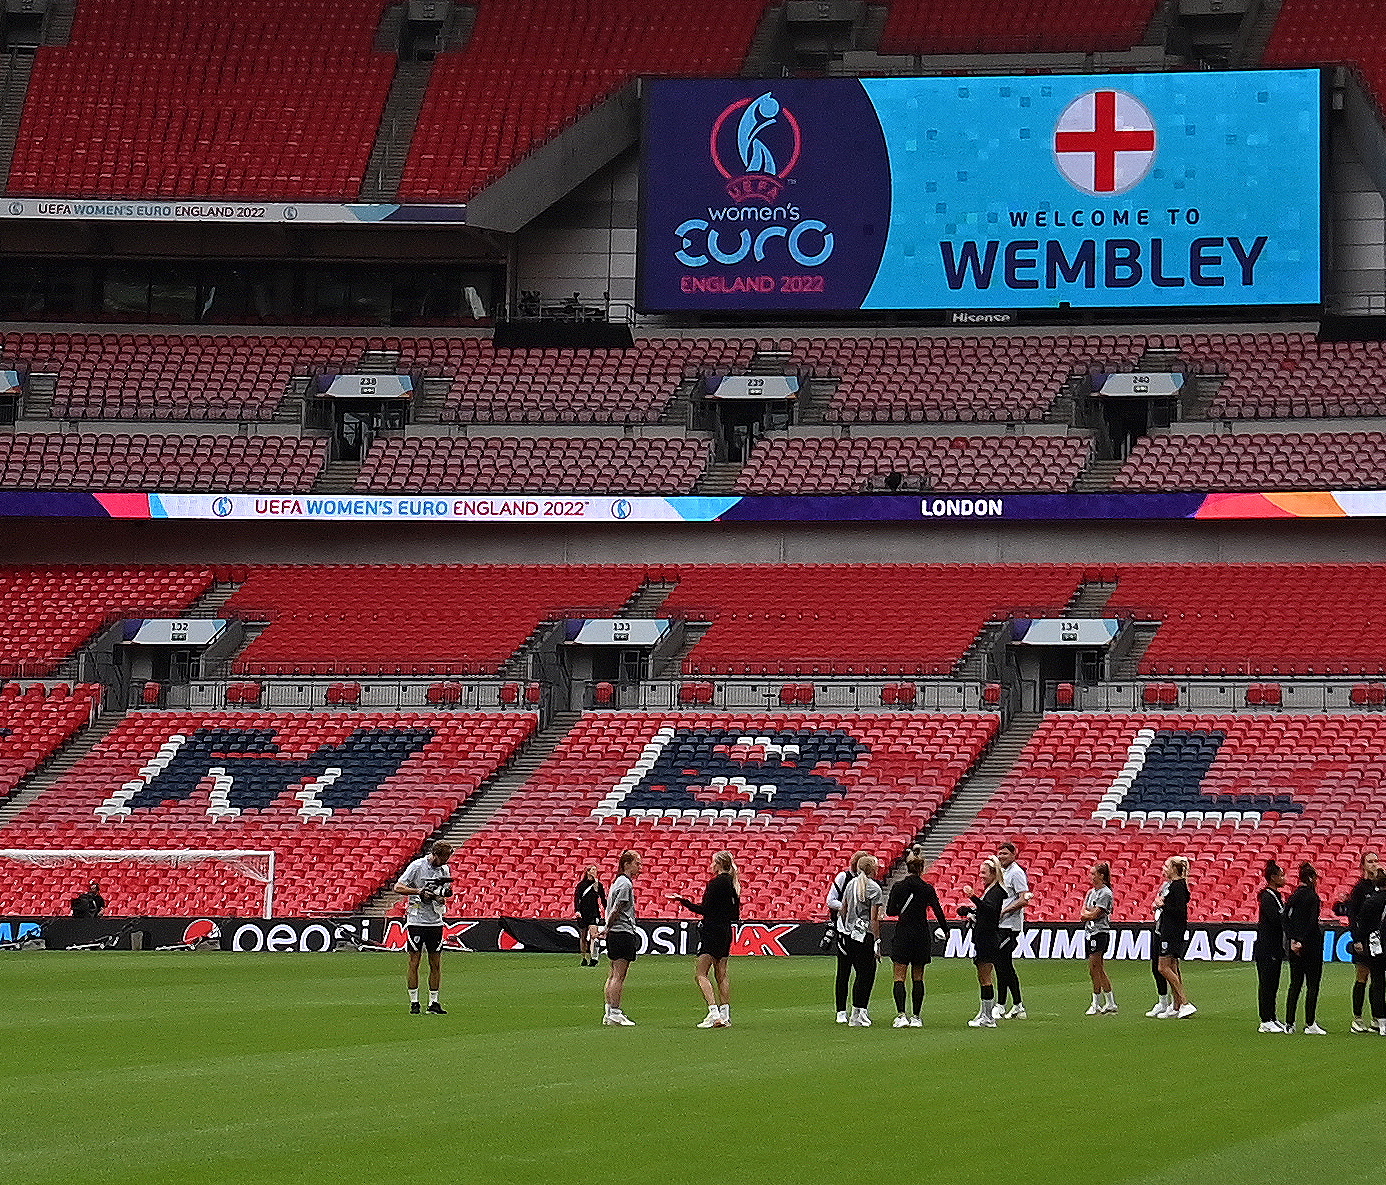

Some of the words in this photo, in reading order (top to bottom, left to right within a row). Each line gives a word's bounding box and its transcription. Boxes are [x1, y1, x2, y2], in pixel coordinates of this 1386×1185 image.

[38, 203, 72, 216] UEFA
[73, 203, 134, 217] WOMEN'S
[136, 205, 171, 217] EURO
[174, 206, 234, 218] ENGLAND
[236, 207, 266, 218] 2022
[708, 203, 800, 221] women's
[1010, 209, 1149, 228] WELCOME
[1168, 208, 1201, 225] TO
[939, 236, 1268, 290] WEMBLEY
[680, 276, 775, 293] ENGLAND
[780, 275, 825, 292] 2022
[255, 499, 303, 515] UEFA
[305, 499, 393, 516] WOMEN'S
[398, 500, 448, 516] EURO
[454, 500, 538, 517] ENGLAND
[543, 501, 586, 517] 2022
[921, 498, 1003, 516] LONDON
[171, 622, 189, 631] 132
[612, 622, 631, 631] 133
[1061, 622, 1080, 631] 134
[381, 920, 479, 952] MX
[729, 923, 801, 956] AX
[944, 928, 1151, 959] MXIMM
[1183, 929, 1258, 961] AST
